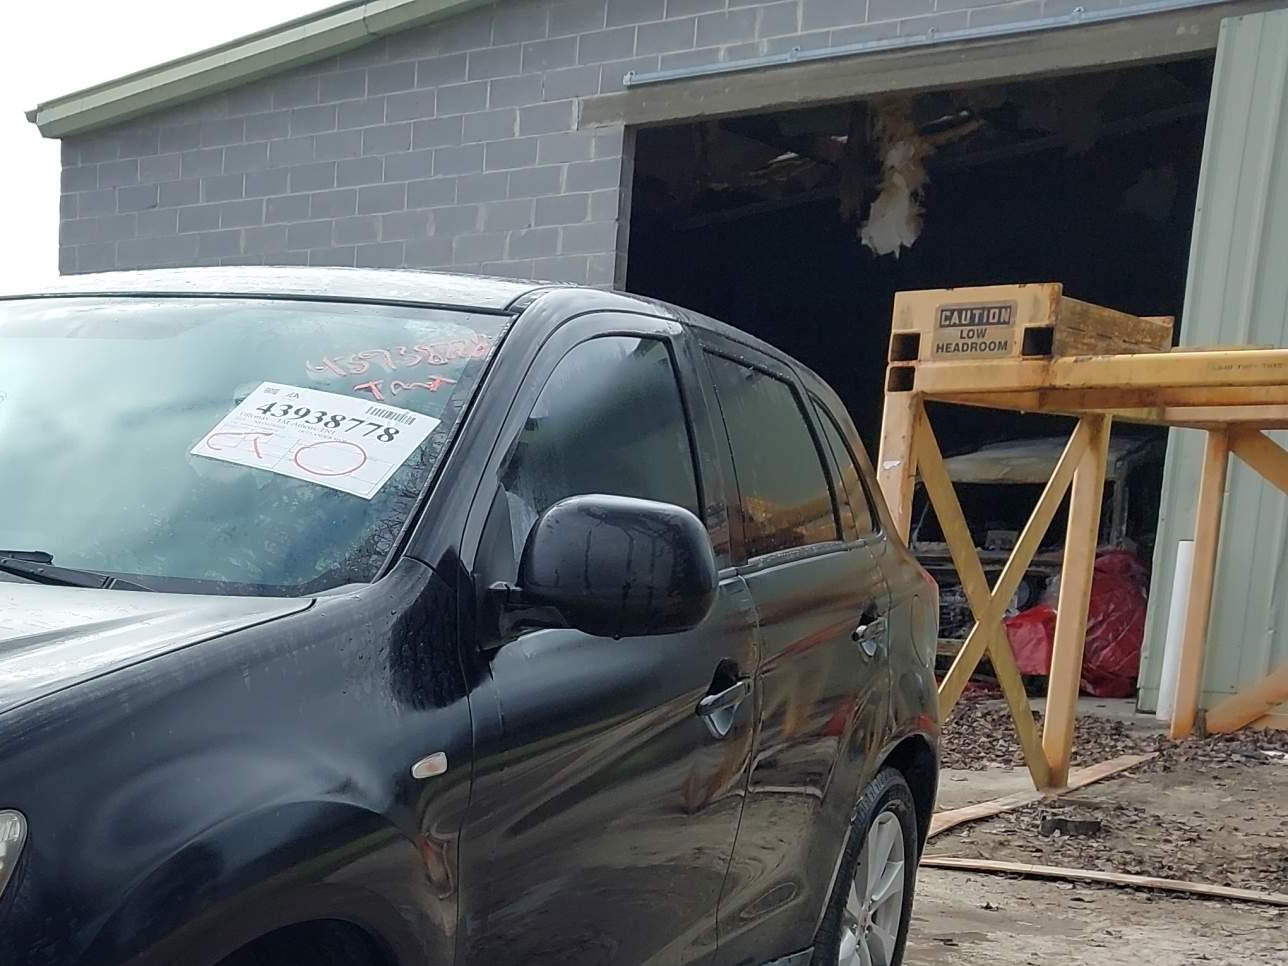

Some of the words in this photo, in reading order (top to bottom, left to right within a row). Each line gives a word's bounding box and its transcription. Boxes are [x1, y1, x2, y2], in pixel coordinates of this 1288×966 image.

[941, 308, 1010, 326] CAUTION
[959, 328, 987, 339] LOW
[936, 341, 1008, 353] HEADROOM
[256, 401, 400, 443] 43938778
